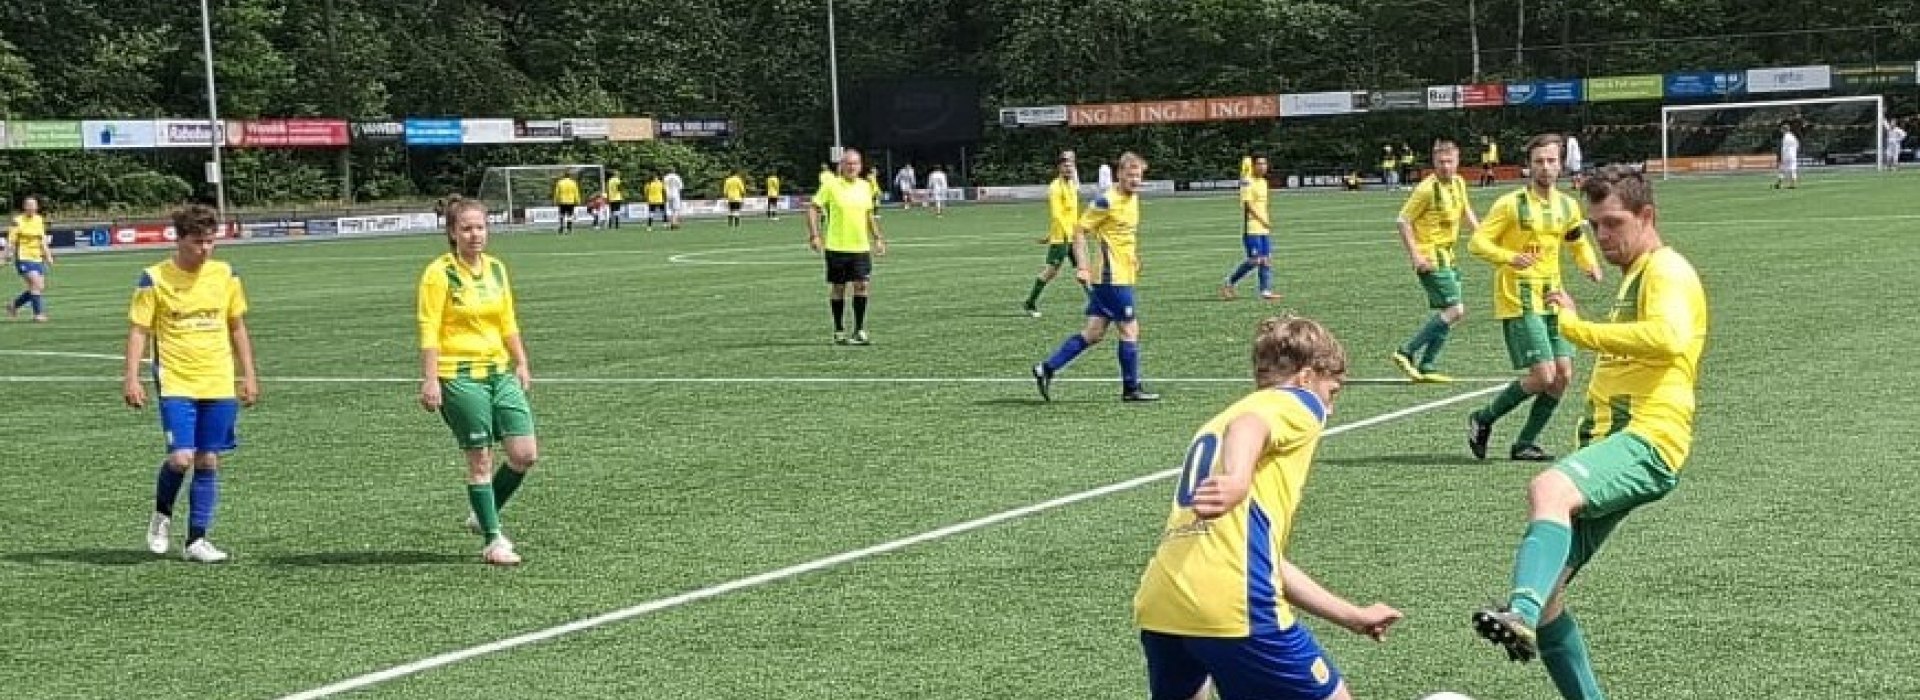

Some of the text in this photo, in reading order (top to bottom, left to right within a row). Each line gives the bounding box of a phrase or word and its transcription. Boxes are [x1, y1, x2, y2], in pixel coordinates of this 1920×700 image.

[1072, 110, 1108, 124] ING
[1141, 106, 1177, 121] ING
[1211, 102, 1247, 117] ING
